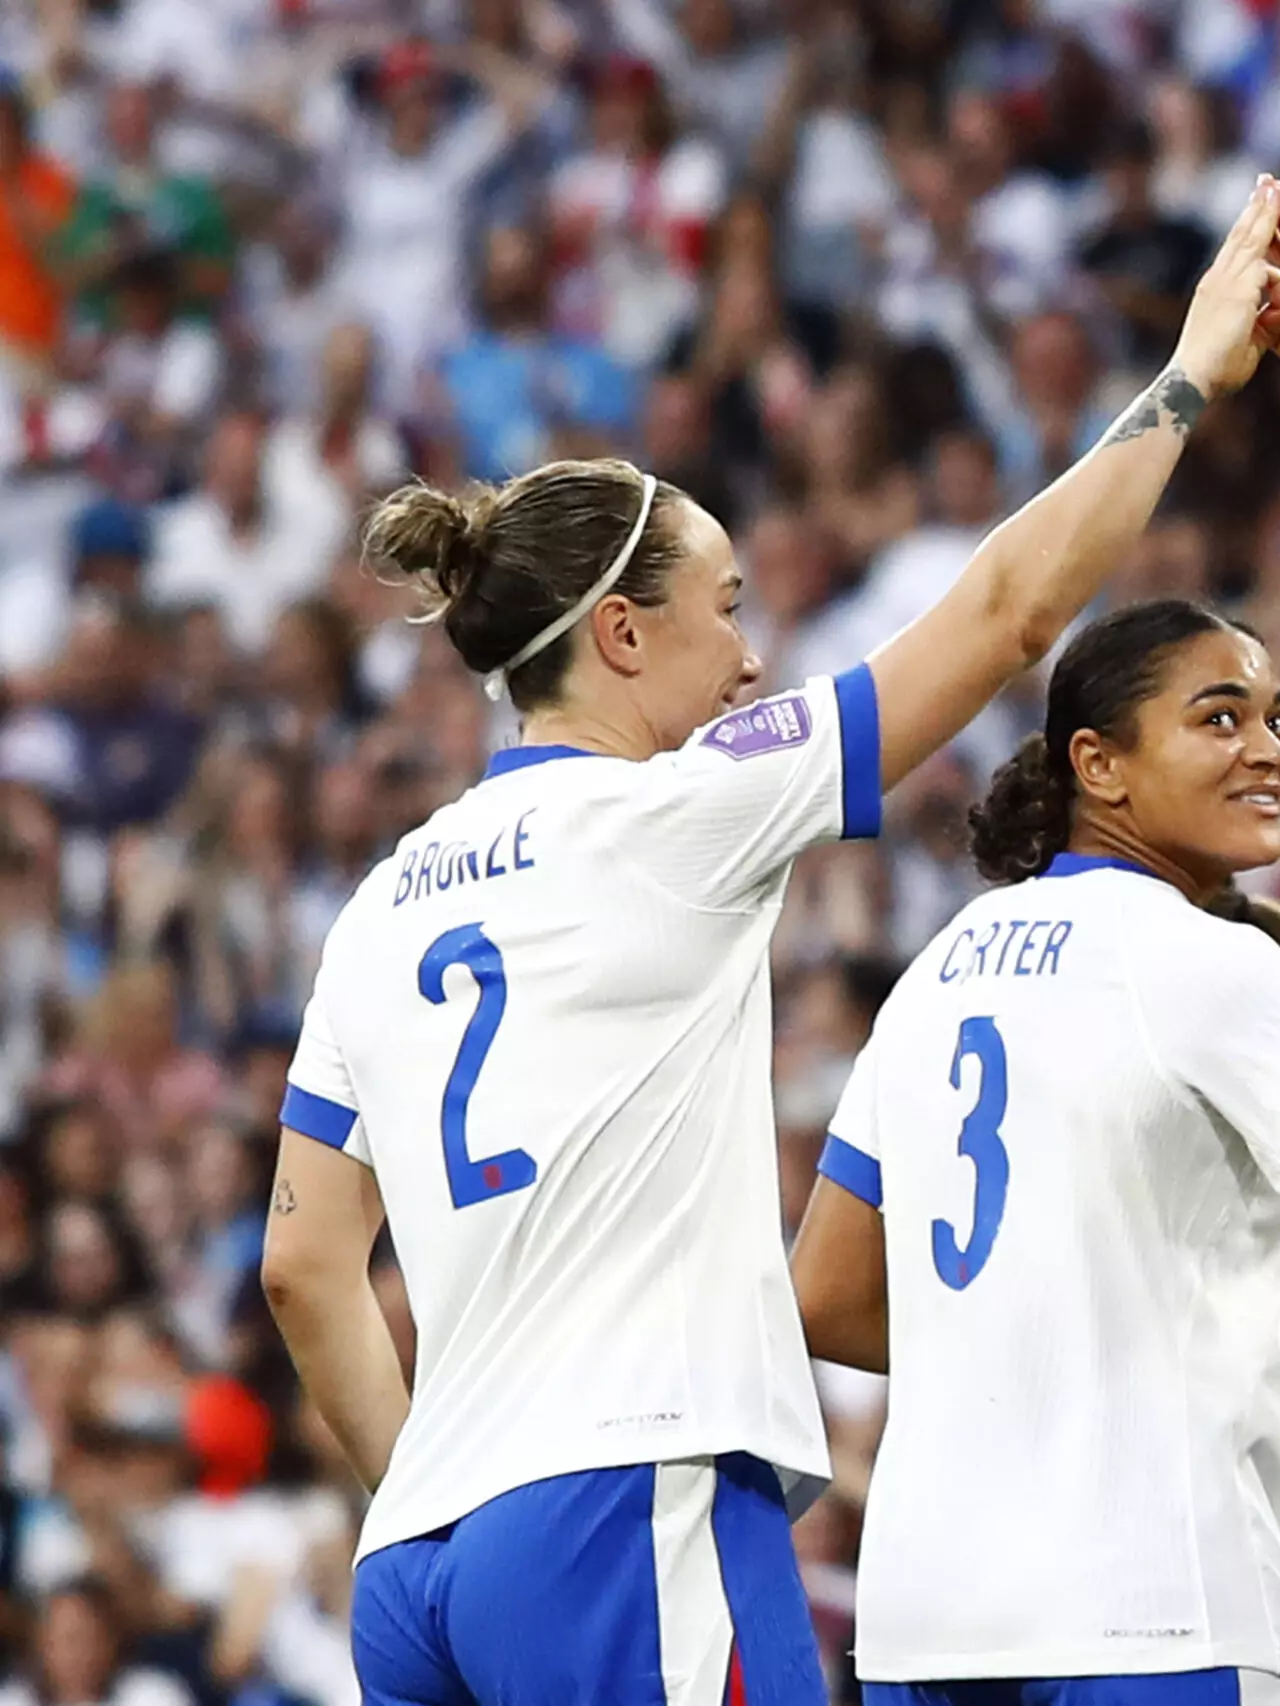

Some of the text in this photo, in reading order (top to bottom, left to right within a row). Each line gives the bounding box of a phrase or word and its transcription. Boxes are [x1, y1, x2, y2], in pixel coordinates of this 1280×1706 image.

[393, 806, 538, 908] BRONZE
[939, 920, 1073, 985] CRTER
[417, 921, 537, 1210] 2
[931, 1015, 1009, 1291] 3
